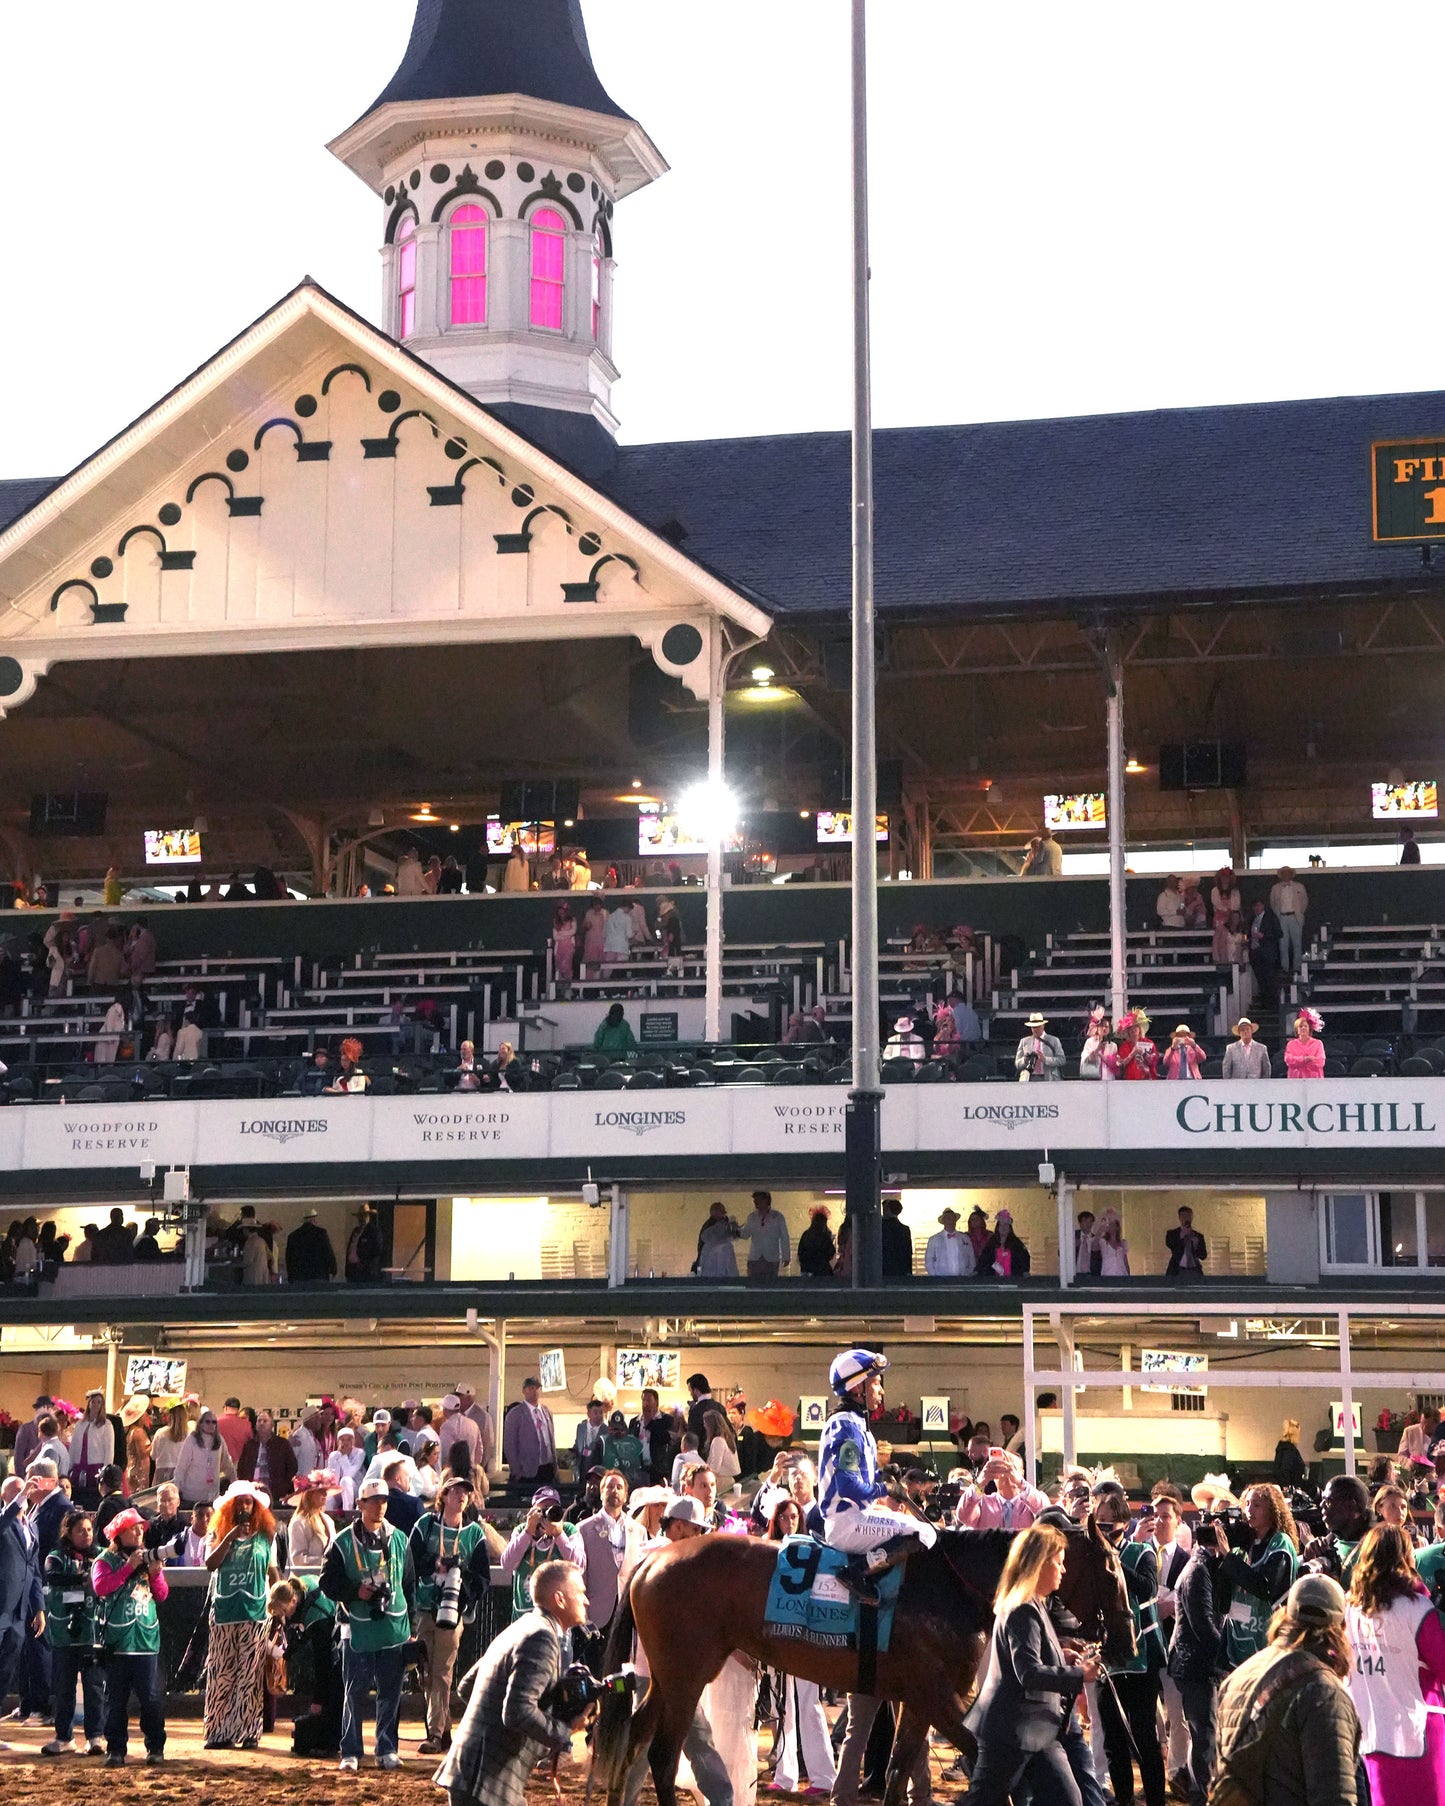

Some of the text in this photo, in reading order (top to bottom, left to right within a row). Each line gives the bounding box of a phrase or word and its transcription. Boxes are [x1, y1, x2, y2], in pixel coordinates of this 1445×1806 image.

[774, 1106, 846, 1117] WOODFO
[963, 1105, 1059, 1120] LONGINES
[1176, 1095, 1436, 1133] CHURCHILL
[413, 1113, 510, 1125] WOODFORD
[594, 1111, 686, 1126] LONGINES
[64, 1122, 158, 1133] WOODFORD
[239, 1119, 328, 1134] LONGINES
[784, 1122, 843, 1134] RESER
[422, 1130, 501, 1141] RESERVE
[72, 1138, 150, 1150] RESERVE
[867, 1515, 896, 1526] HORSE
[780, 1541, 822, 1595] 9
[229, 1572, 255, 1586] 227
[817, 1581, 837, 1591] 152
